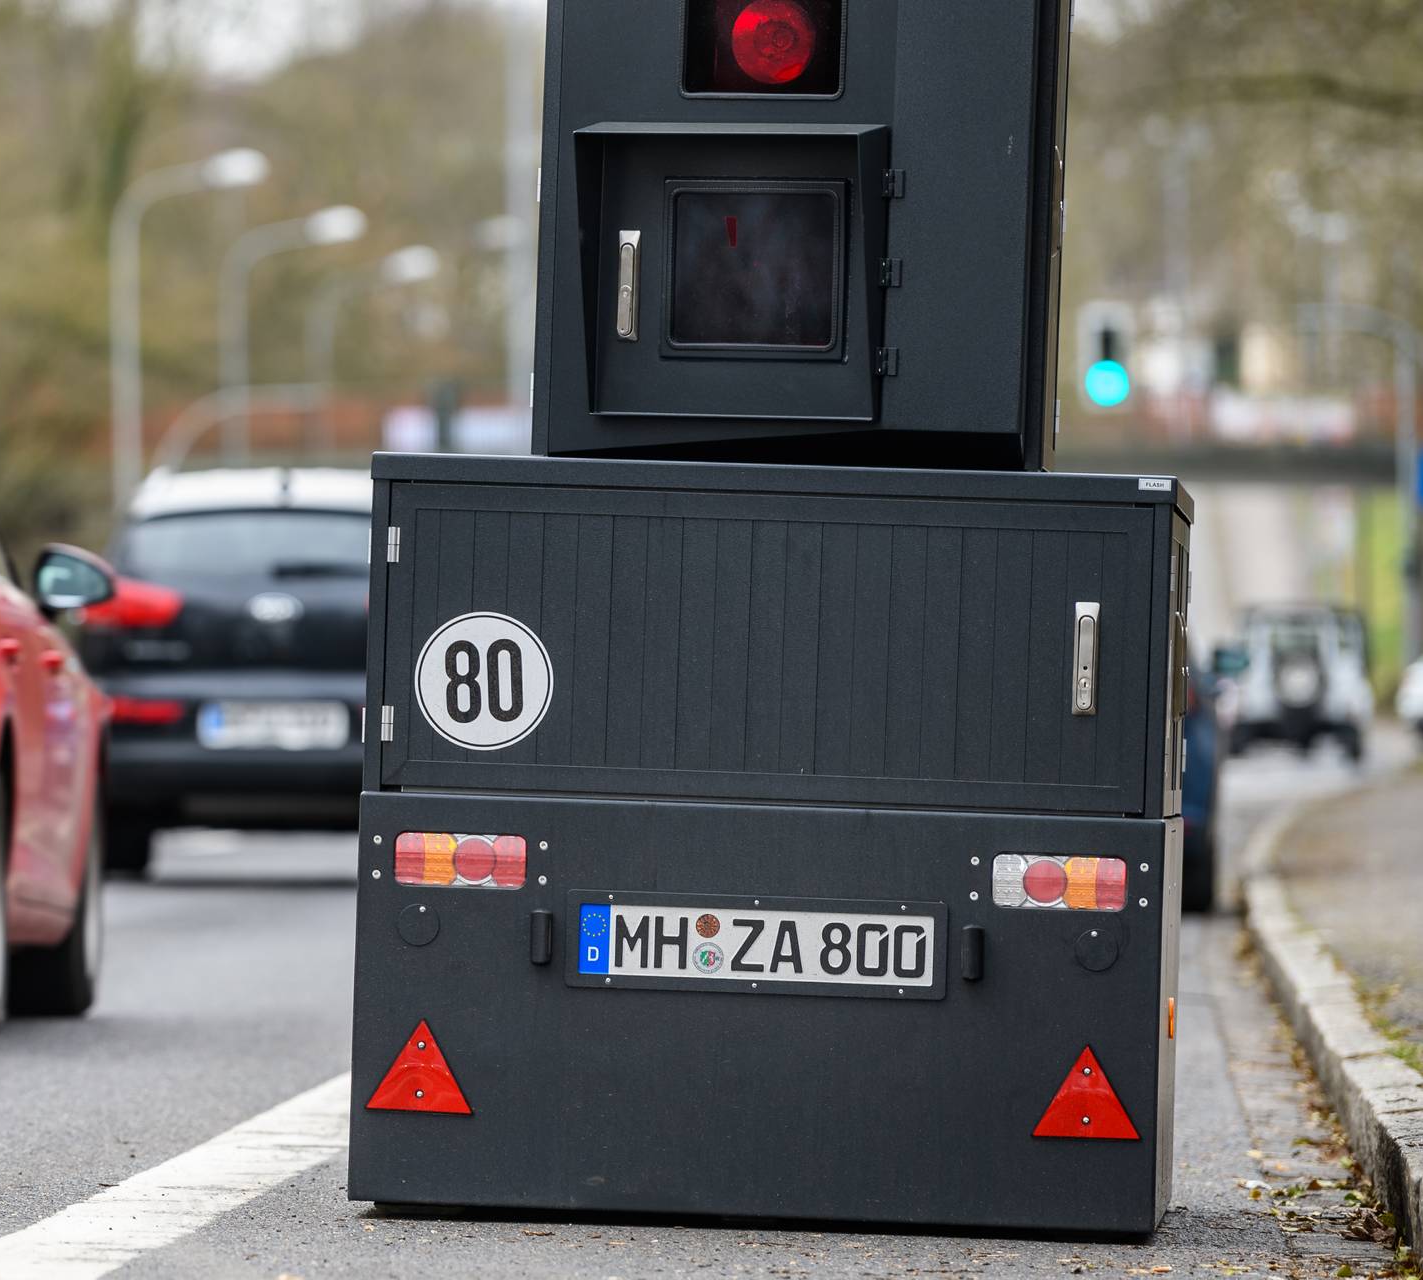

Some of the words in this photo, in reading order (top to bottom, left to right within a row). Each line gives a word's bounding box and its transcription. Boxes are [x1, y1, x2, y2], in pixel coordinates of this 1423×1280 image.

[445, 638, 524, 723] 80
[587, 946, 599, 961] D
[614, 914, 688, 970] MH
[730, 918, 803, 974] ZA
[819, 922, 927, 979] 800
